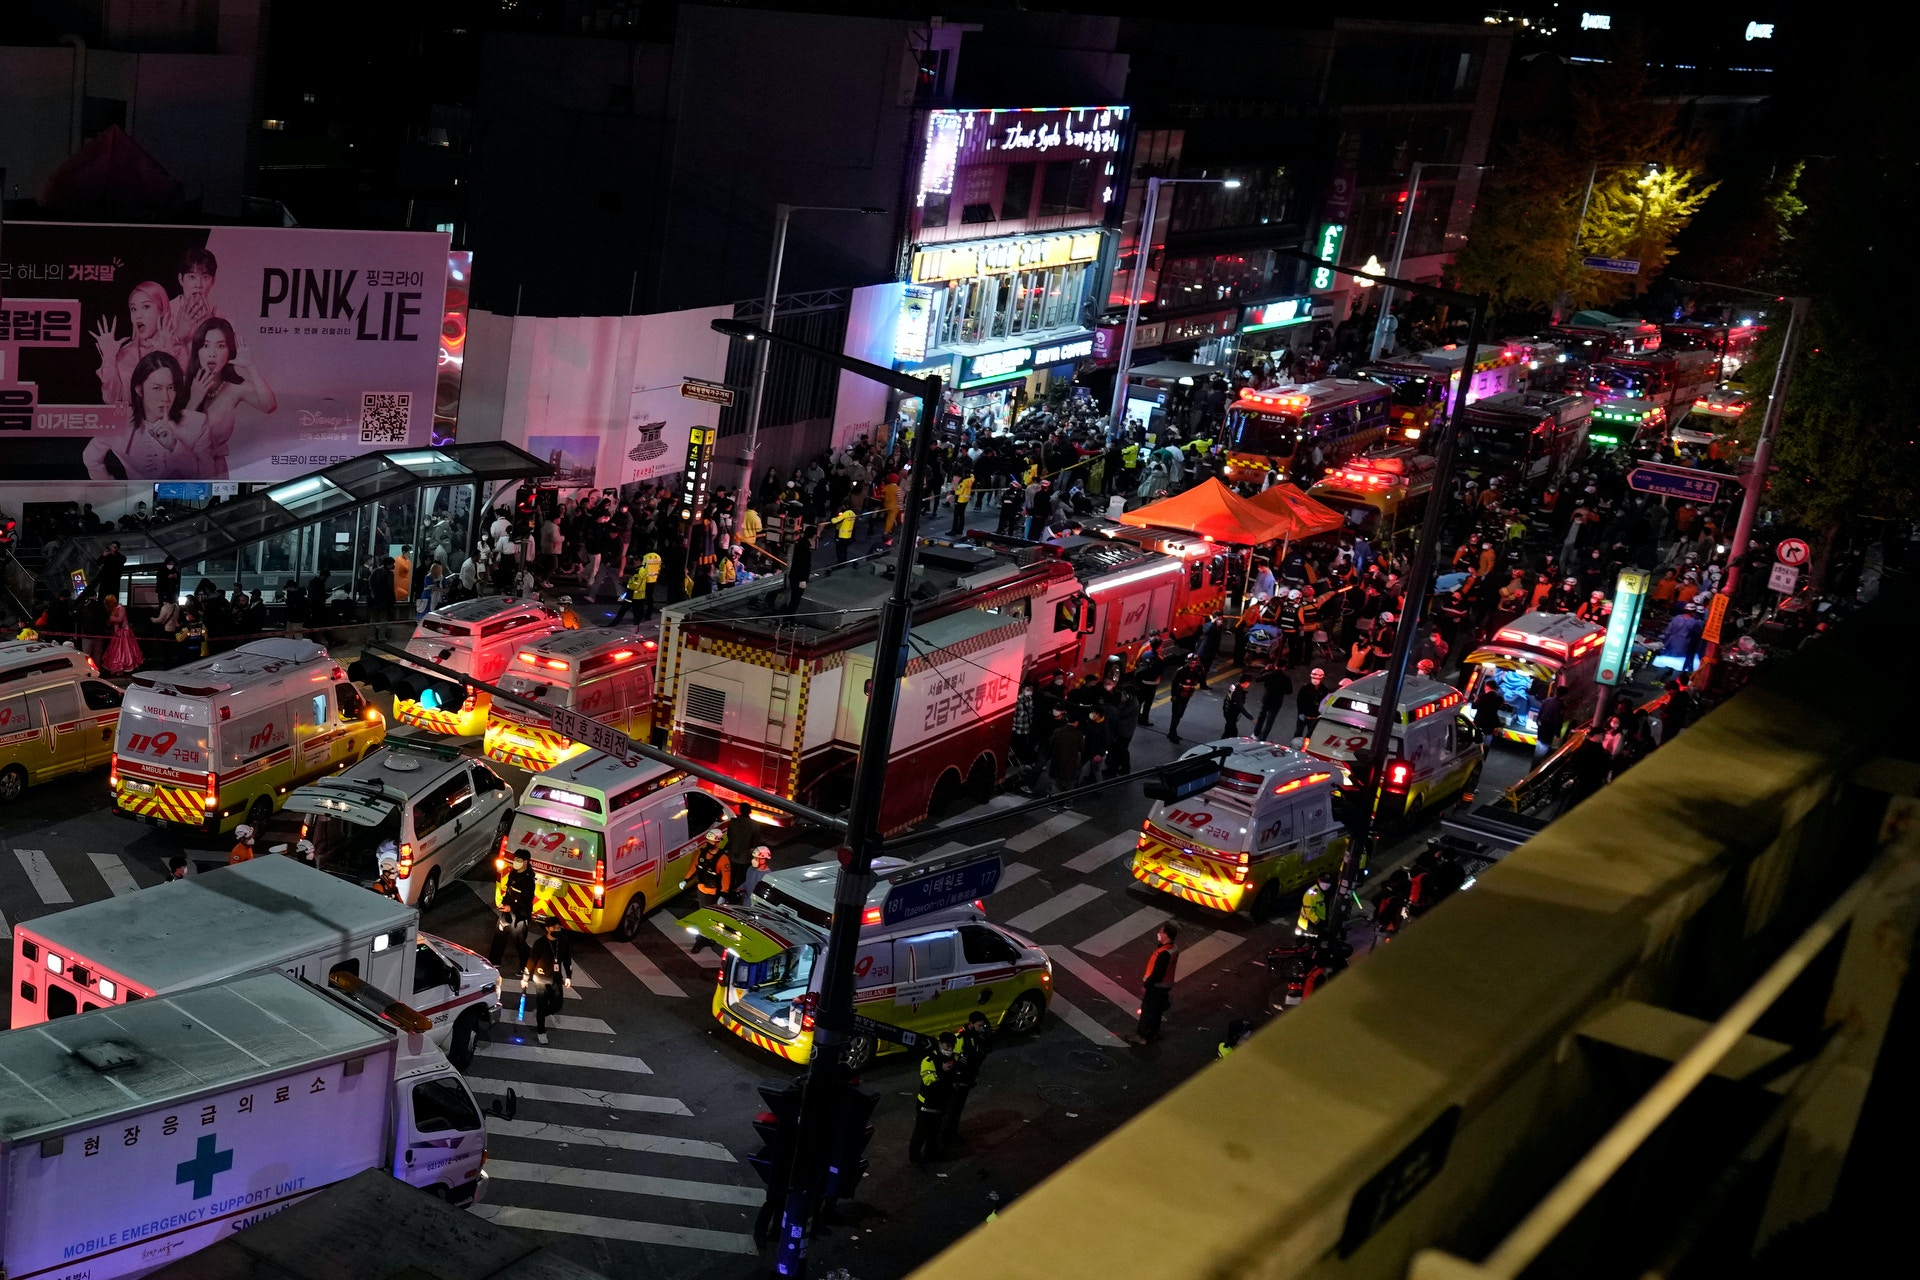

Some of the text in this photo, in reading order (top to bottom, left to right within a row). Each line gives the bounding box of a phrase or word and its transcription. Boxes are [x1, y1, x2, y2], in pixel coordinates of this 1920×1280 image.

[17, 263, 64, 281] 하나의
[68, 264, 116, 282] 거짓말
[366, 270, 424, 287] 핑크라이
[260, 268, 359, 322] PINK
[356, 292, 422, 341] LIE
[1061, 340, 1093, 360] COFFEE
[37, 413, 116, 430] 이거든요...
[297, 409, 353, 430] Disney+
[692, 445, 698, 454] 4
[271, 455, 307, 465] 핑크문이
[309, 455, 328, 465] 뜨면
[1684, 479, 1714, 492] 보광로
[927, 671, 966, 698] 서울특별시
[923, 674, 1010, 731] 긴급구조통제단
[143, 706, 189, 721] AMBULANCE
[249, 722, 273, 752] 119
[554, 711, 627, 756] 직진 후 좌회전
[126, 731, 199, 764] 119 구급대
[141, 765, 180, 778] AMBULANCE
[1166, 809, 1230, 841] 119 구급대
[1260, 820, 1282, 842] 119
[520, 831, 565, 851] 119
[1171, 837, 1209, 854] AMBULANCE
[923, 872, 964, 896] 이태원로
[981, 869, 997, 886] 177
[888, 897, 903, 914] 181
[904, 897, 945, 918] Itaewon-ro
[871, 966, 889, 977] 구급대
[64, 1177, 306, 1259] MOBILE EMERGENCY SUPPORT UNIT
